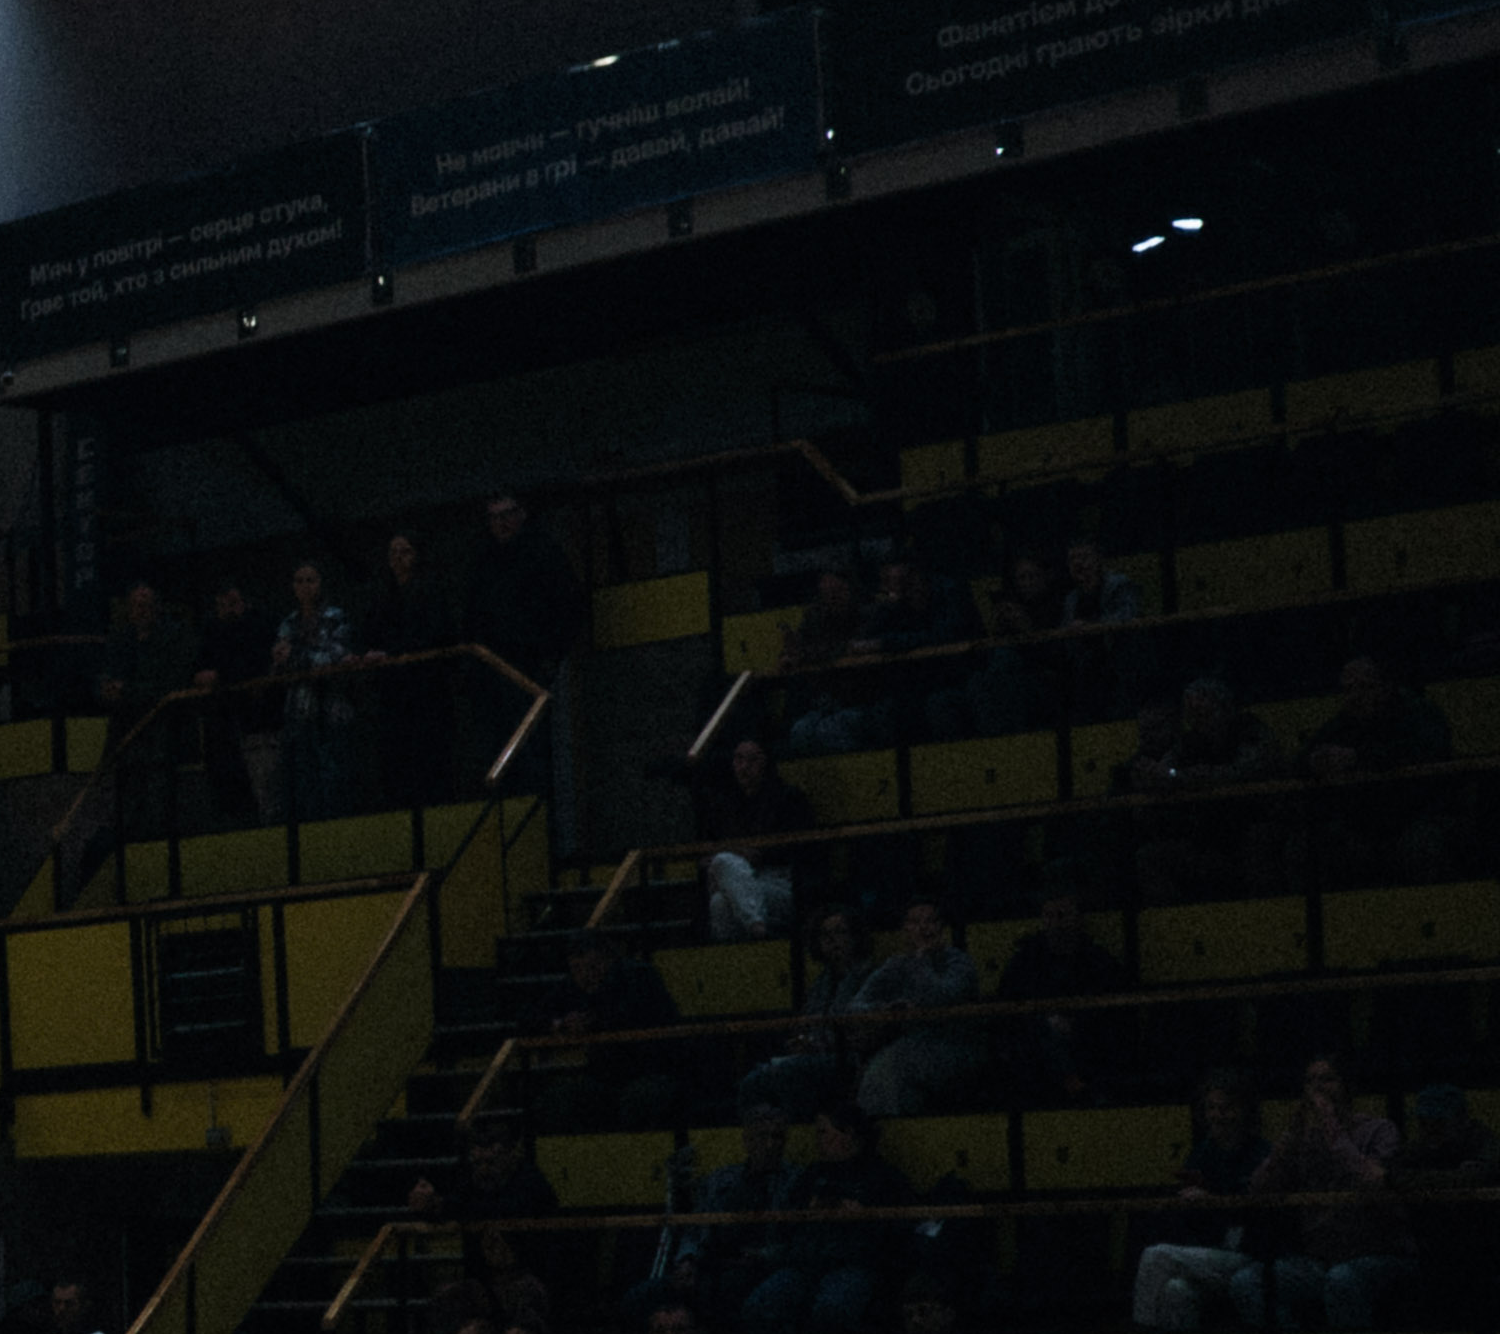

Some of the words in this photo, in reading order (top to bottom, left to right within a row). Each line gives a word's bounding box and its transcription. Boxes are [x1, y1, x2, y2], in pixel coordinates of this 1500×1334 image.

[904, 43, 1029, 96] Сьогодні
[1035, 25, 1143, 68] грають
[409, 172, 521, 218] Ветерани
[77, 257, 89, 278] у
